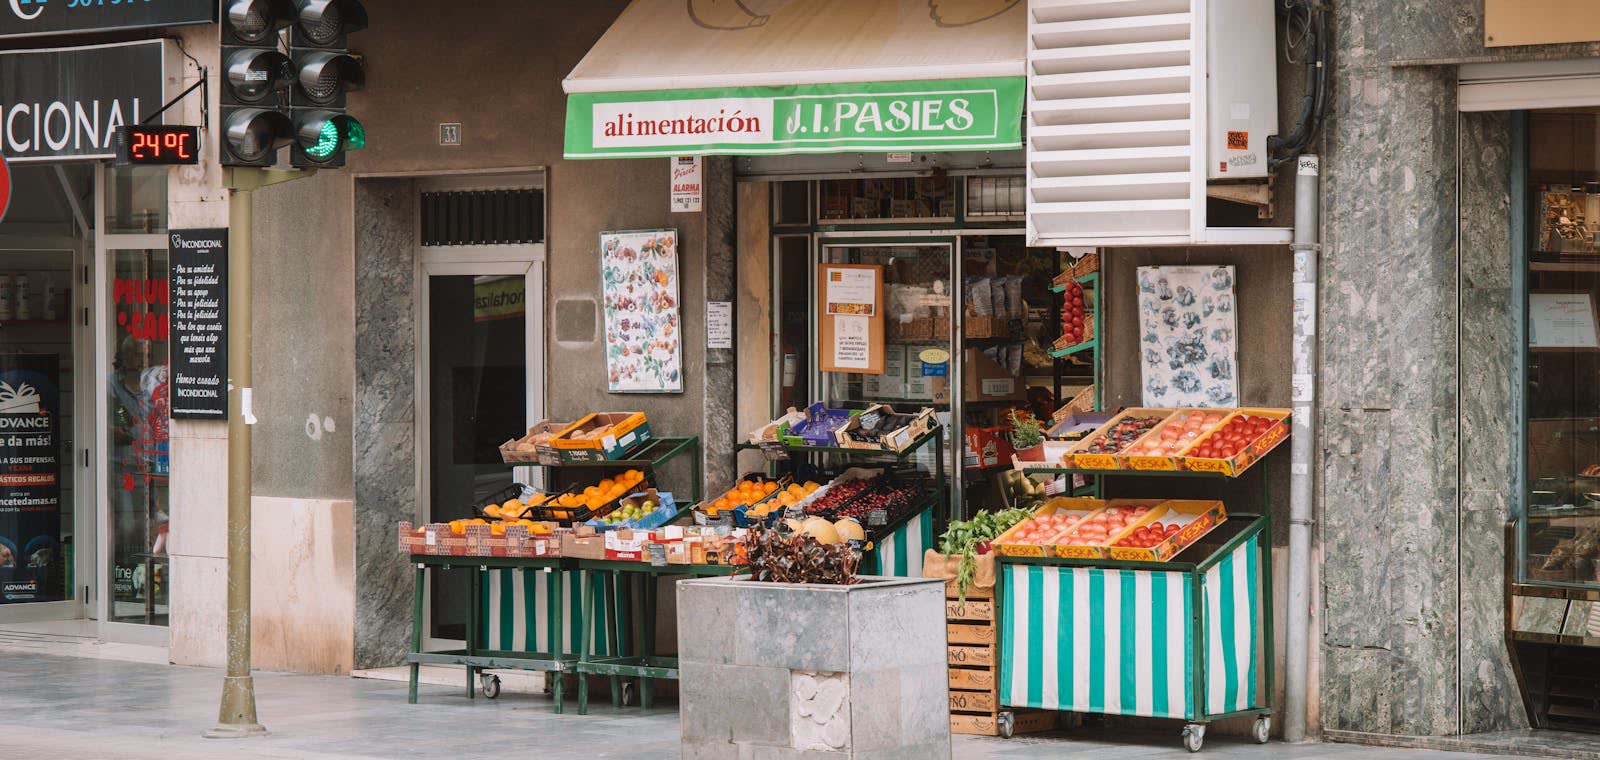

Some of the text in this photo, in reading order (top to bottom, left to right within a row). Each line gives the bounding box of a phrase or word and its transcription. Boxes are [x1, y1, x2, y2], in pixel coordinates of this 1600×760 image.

[604, 110, 761, 137] alimentación
[444, 126, 457, 143] 33
[673, 184, 700, 192] ALARMA
[182, 240, 222, 248] INCONDICIONAL
[178, 388, 218, 398] INCONDICIONAL
[0, 416, 49, 428] DVANCE
[8, 436, 22, 447] da
[26, 434, 51, 446] más!
[1254, 425, 1285, 454] XESKA
[1077, 457, 1112, 468] XESKA
[1131, 457, 1169, 469] XESKA
[1188, 458, 1225, 471] XESKA
[1003, 546, 1040, 556] XESKA
[1058, 548, 1095, 558] XESKA
[1112, 550, 1150, 561] XESKA
